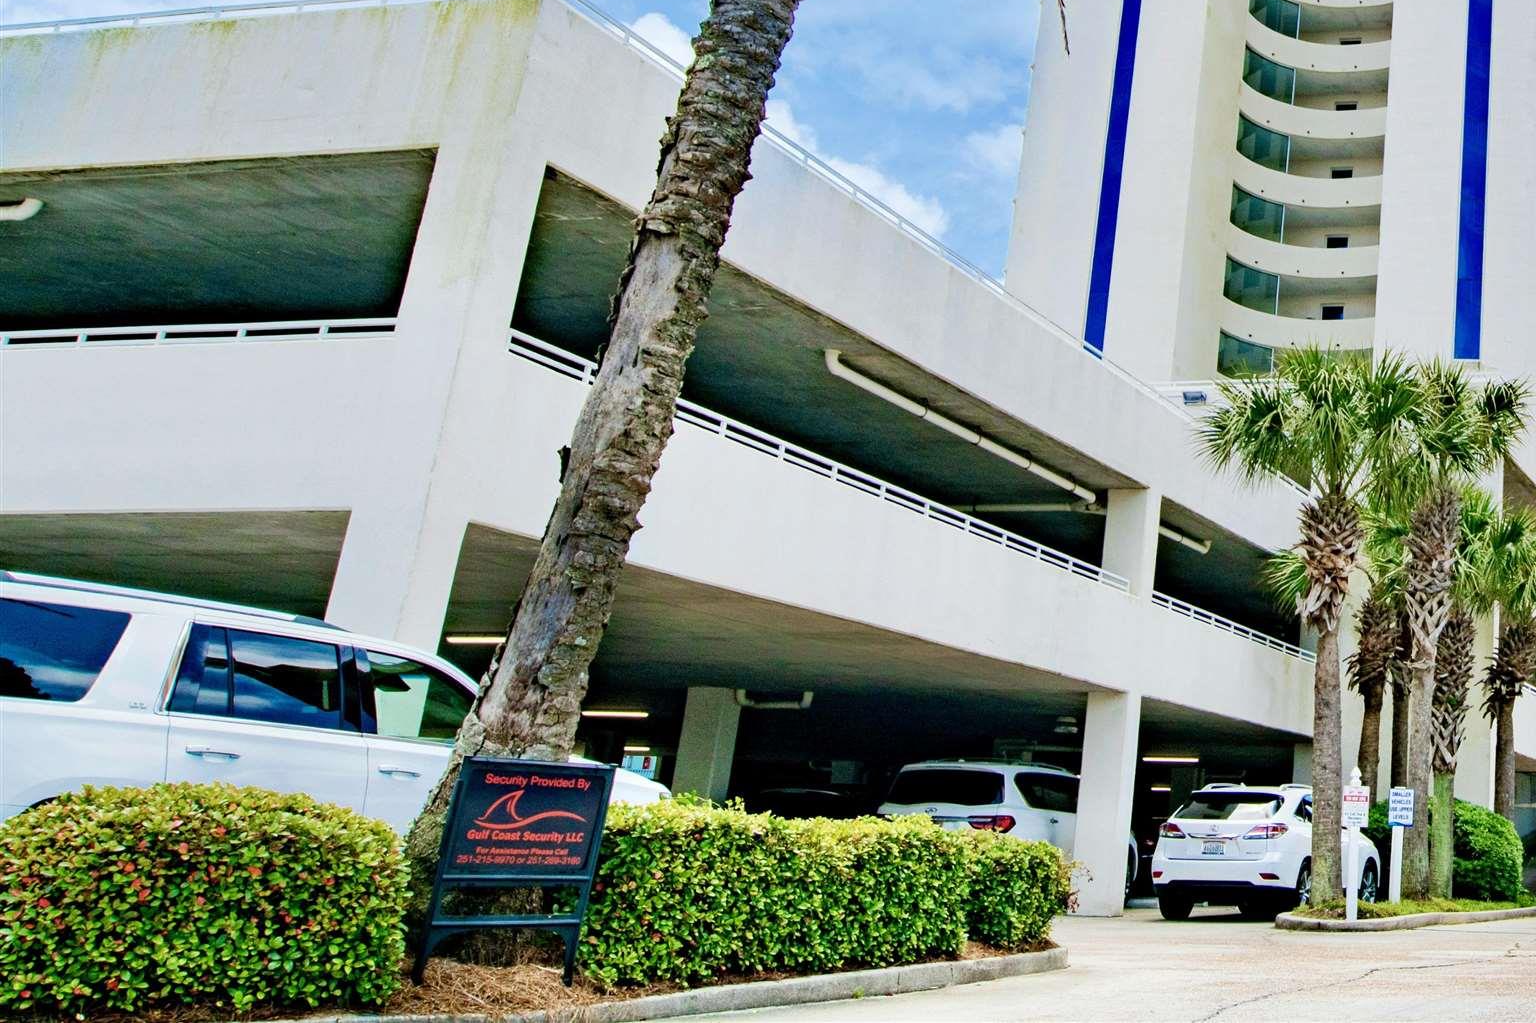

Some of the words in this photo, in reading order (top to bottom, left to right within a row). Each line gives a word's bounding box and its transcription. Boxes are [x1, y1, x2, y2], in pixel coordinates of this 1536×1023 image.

[485, 773, 528, 788] Security
[530, 776, 576, 788] Provided
[577, 778, 591, 792] By
[466, 829, 489, 839] Gulf
[492, 830, 521, 841] Coast
[523, 831, 563, 843] Security
[565, 832, 584, 842] LLC
[489, 847, 529, 855] Assistance
